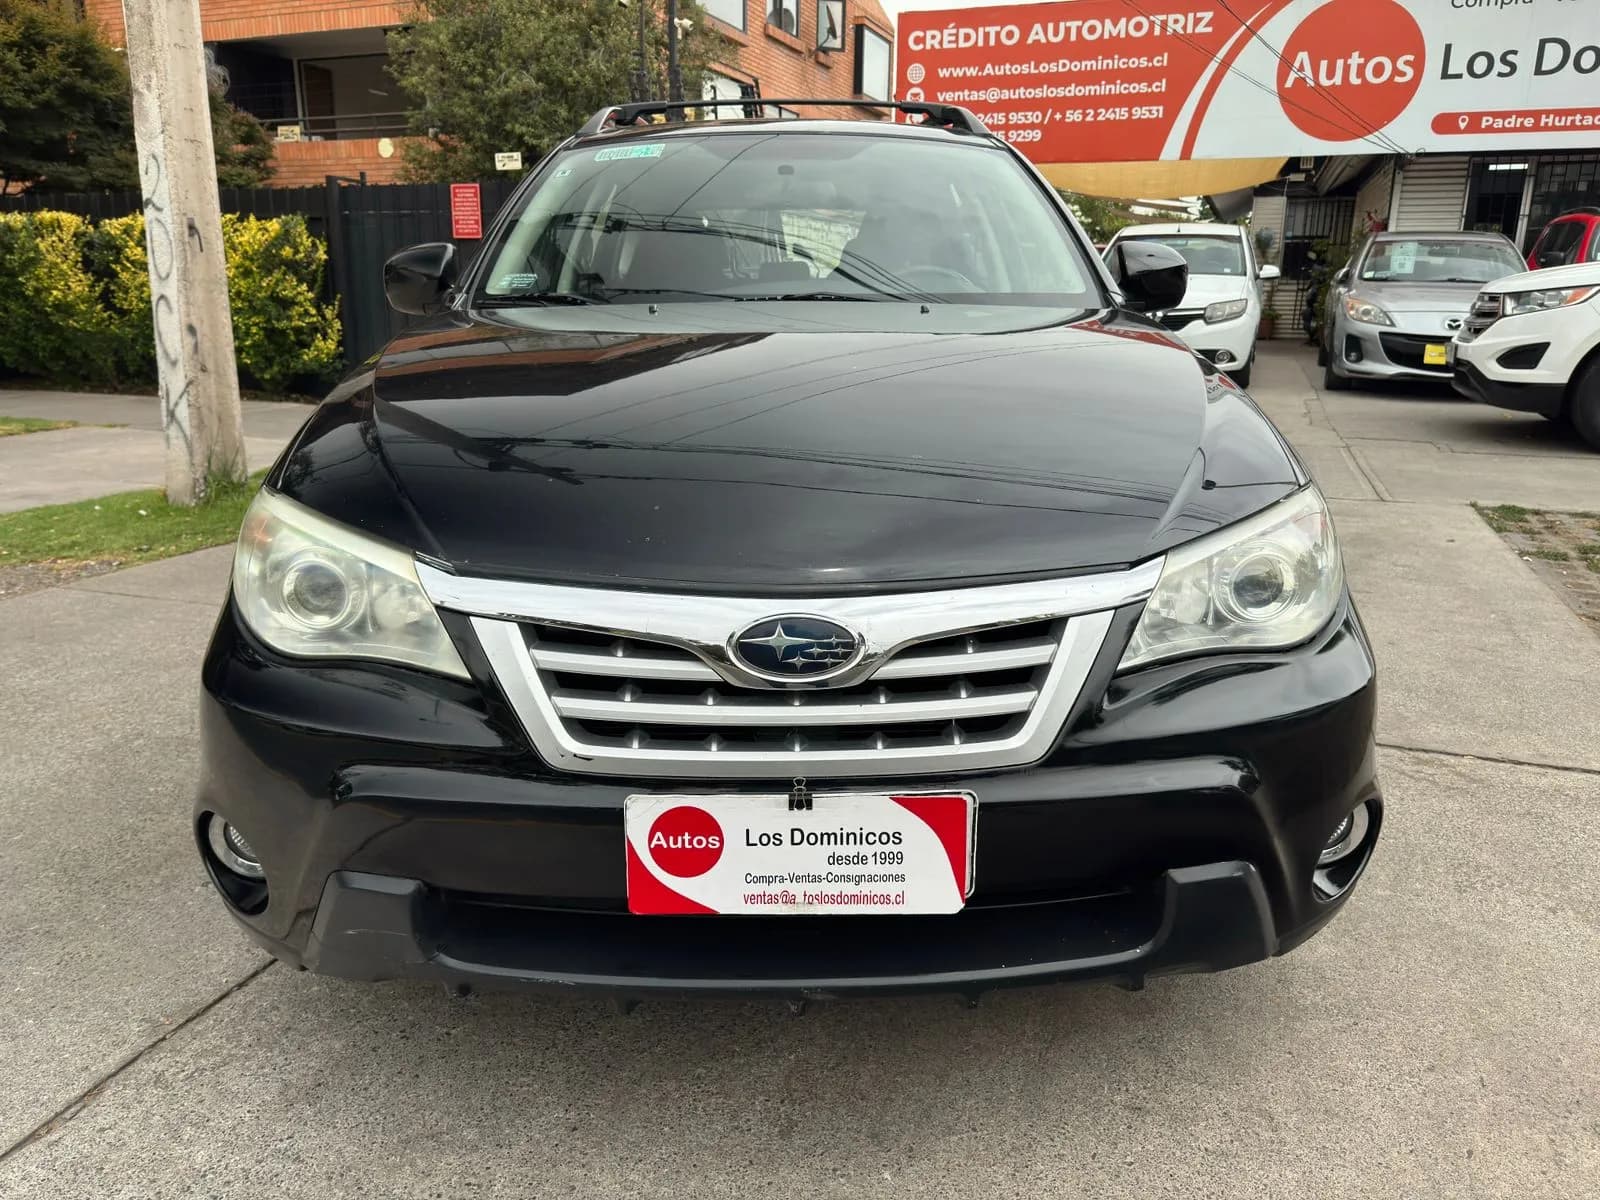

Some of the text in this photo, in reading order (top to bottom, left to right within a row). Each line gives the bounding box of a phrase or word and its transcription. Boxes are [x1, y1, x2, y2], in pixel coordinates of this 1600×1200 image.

[1451, 0, 1533, 9] Comp
[908, 11, 1214, 52] CRÉDITO AUTOMOTRIZ
[937, 52, 1169, 79] www.AutosLosDominicos.cl
[1284, 50, 1415, 88] Autos
[1440, 43, 1519, 80] Los
[937, 78, 1167, 103] ventas@autoslosdominicos.cl
[1008, 111, 1042, 125] 9530
[1043, 108, 1052, 125] /
[1065, 109, 1082, 122] 56
[1086, 108, 1095, 121] 2
[1097, 107, 1129, 121] 2415
[1131, 105, 1164, 119] 9531
[1481, 114, 1534, 129] Padre
[1007, 129, 1042, 142] 9299
[649, 831, 721, 850] Autos
[745, 826, 903, 847] Los Dominicos
[827, 850, 904, 866] desde 1999
[744, 871, 906, 885] Compra-Ventas-Consignaciones
[743, 890, 905, 905] ventas@atoslosdominicos.cl
